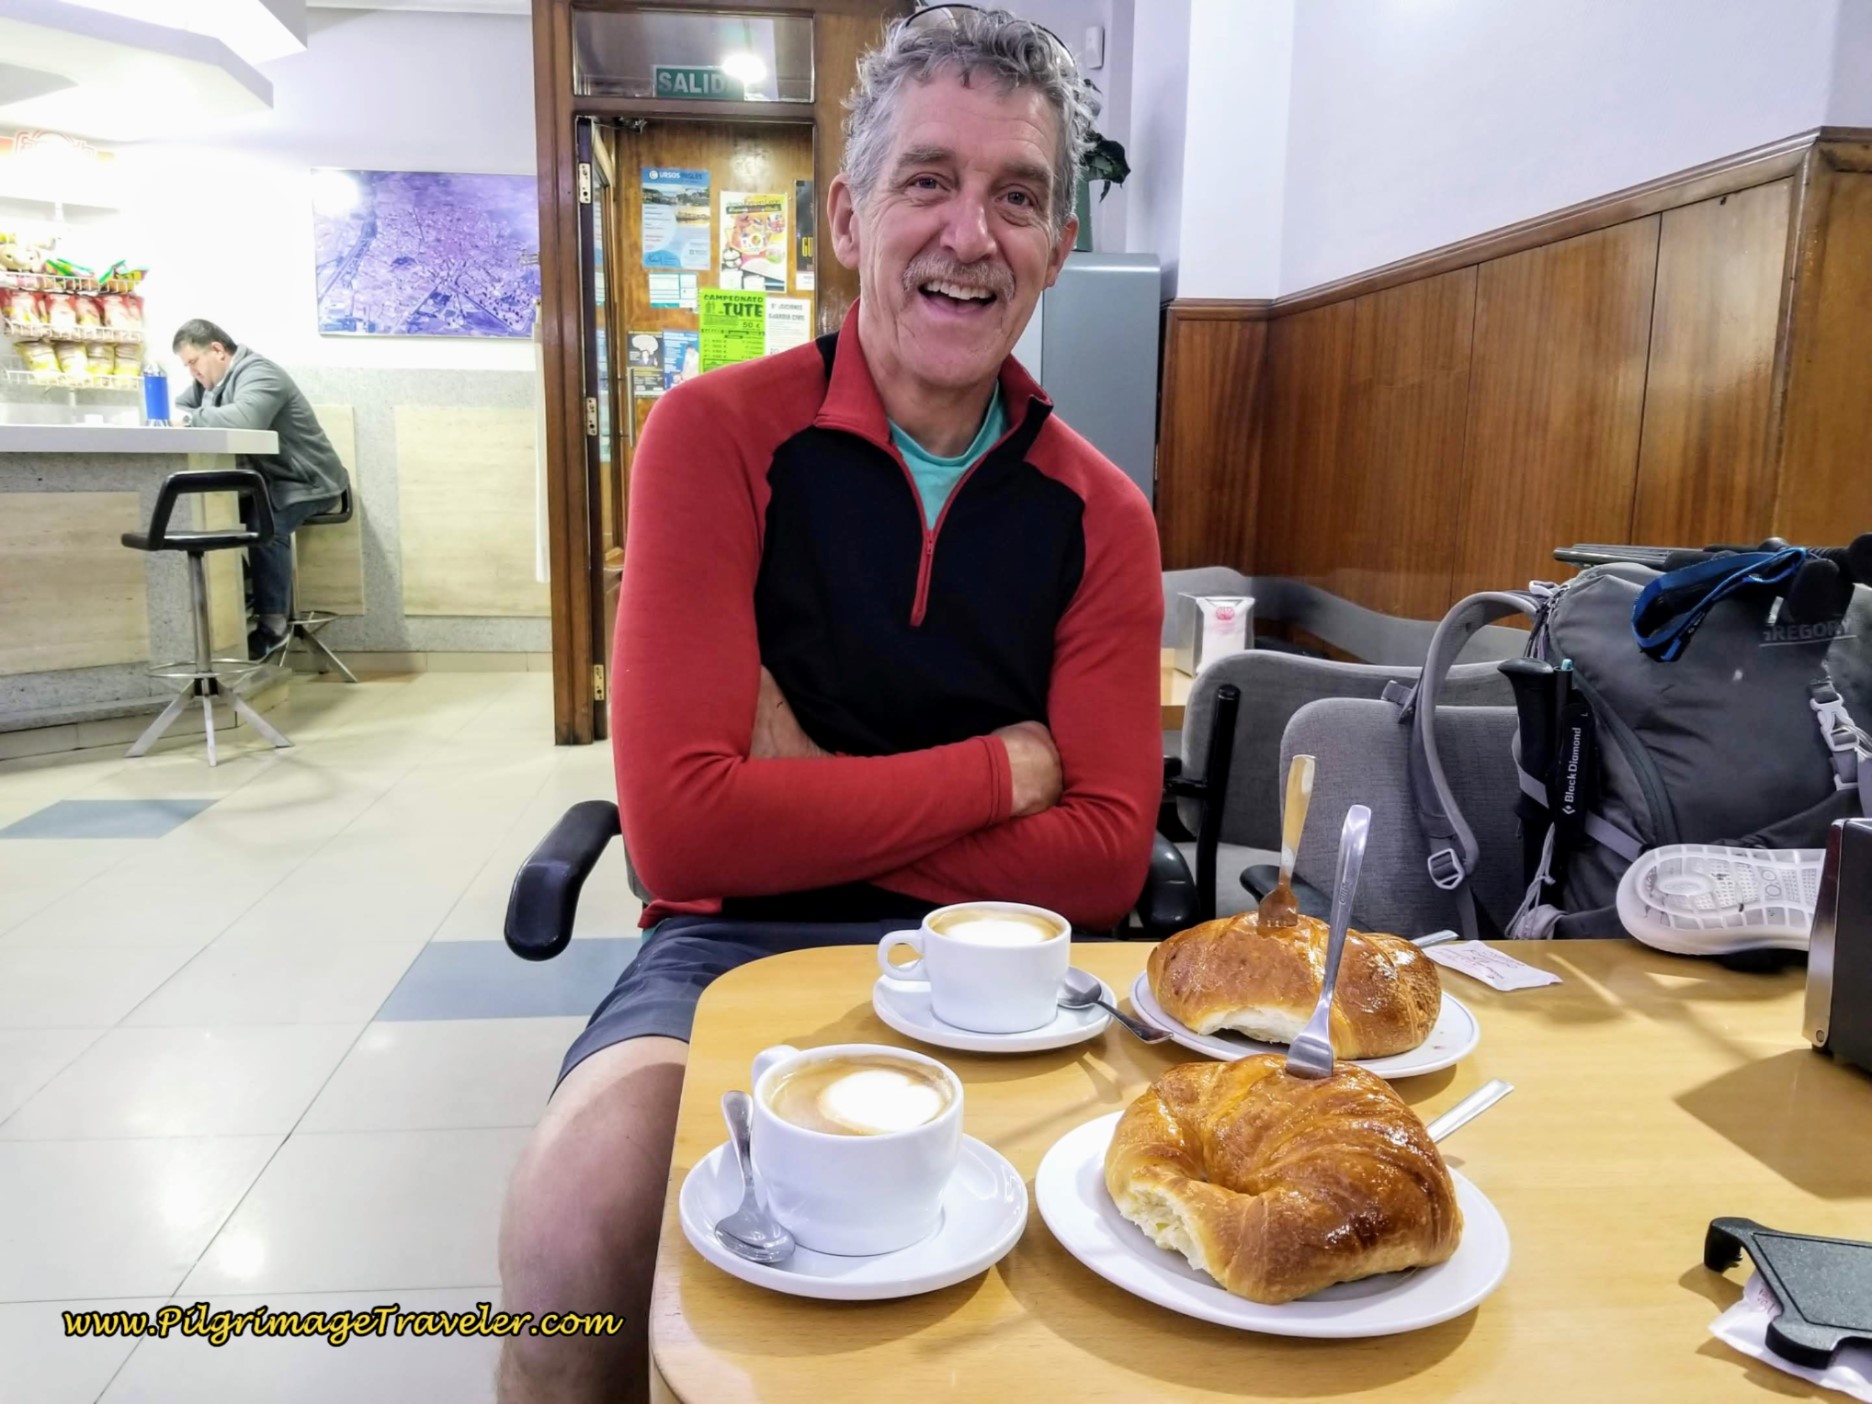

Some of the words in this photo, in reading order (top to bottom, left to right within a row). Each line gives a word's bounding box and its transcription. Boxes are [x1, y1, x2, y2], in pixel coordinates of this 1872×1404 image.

[658, 71, 738, 94] SALID
[703, 294, 764, 303] CAMPEONATO
[723, 302, 763, 317] TUTE
[1568, 727, 1582, 772] Diamond
[1564, 773, 1577, 803] Black
